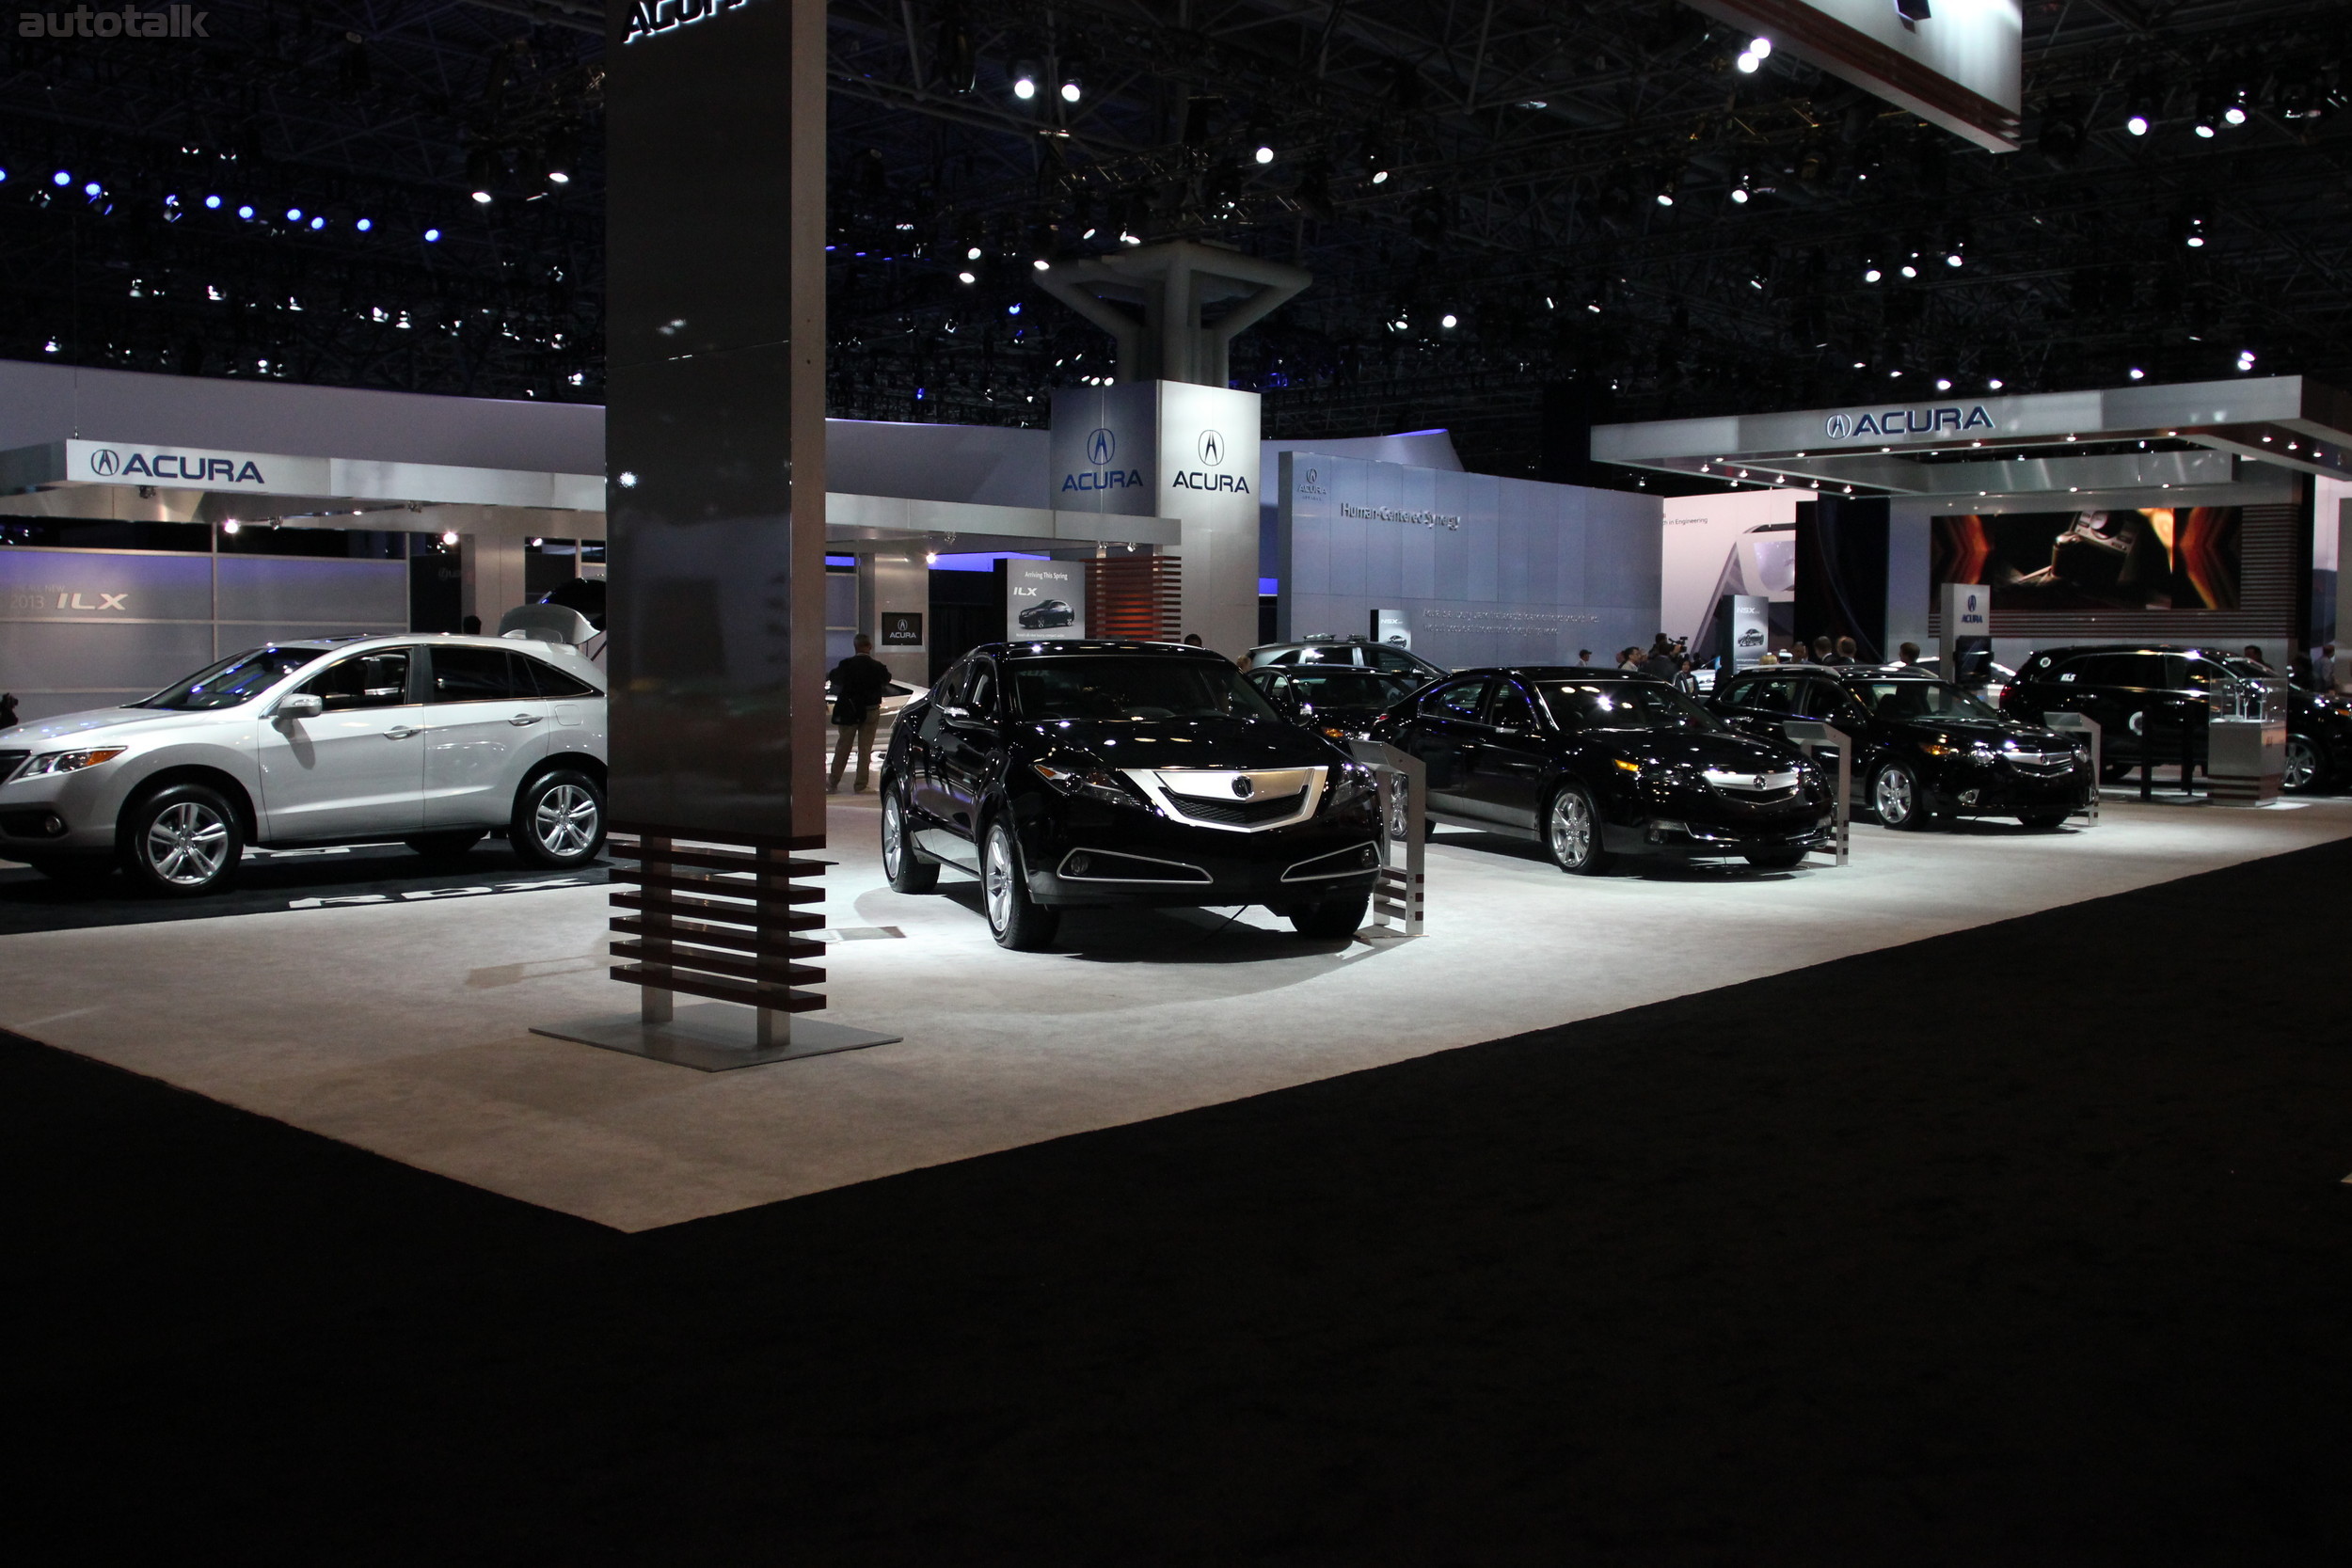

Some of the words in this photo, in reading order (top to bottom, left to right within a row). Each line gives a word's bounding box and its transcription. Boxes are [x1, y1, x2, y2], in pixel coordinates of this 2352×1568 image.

[620, 0, 749, 43] ACU
[1852, 405, 1995, 436] ACURA
[121, 453, 264, 483] ACURA
[1061, 469, 1143, 492] ACURA
[1172, 470, 1249, 494] ACURA
[1297, 484, 1327, 495] ACURA
[1423, 511, 1460, 531] Synergy
[1025, 571, 1043, 579] Arriving
[1053, 572, 1068, 580] Spring
[1013, 586, 1038, 596] ILX
[10, 594, 45, 610] 2013
[56, 593, 129, 610] ILX
[1962, 614, 1983, 624] ACURA
[889, 631, 916, 640] ACURA
[288, 878, 591, 909] RDX
